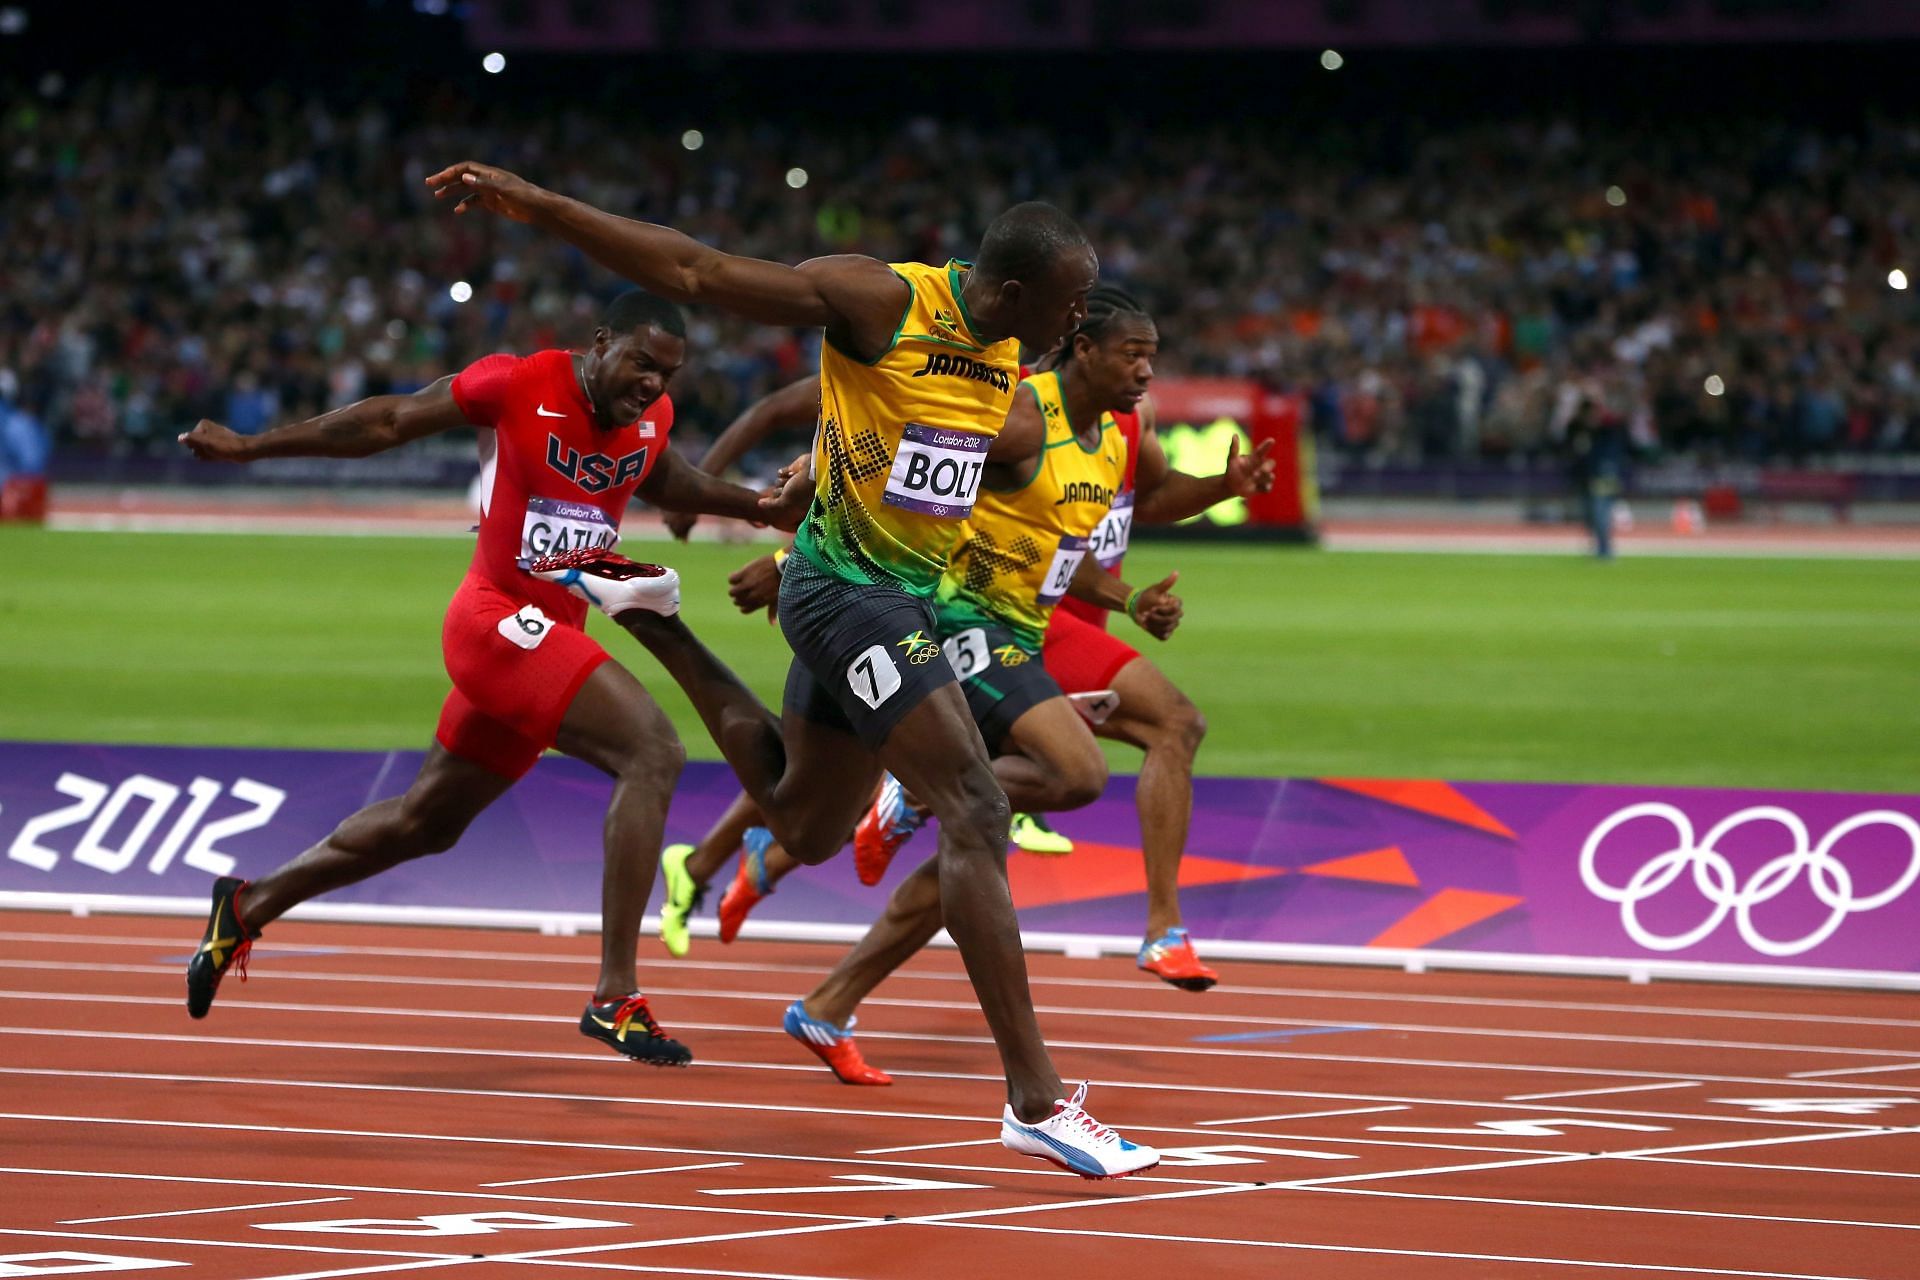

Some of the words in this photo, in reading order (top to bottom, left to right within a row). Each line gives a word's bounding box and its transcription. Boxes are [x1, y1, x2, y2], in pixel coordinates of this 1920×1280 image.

[911, 353, 1010, 396] JAMAICA
[933, 432, 963, 447] London
[964, 437, 981, 448] 2012
[546, 432, 648, 495] USA
[903, 451, 982, 498] BOLT
[1055, 482, 1116, 510] JAMAIC
[556, 505, 590, 519] London
[590, 509, 604, 521] 20
[515, 613, 545, 636] 6
[955, 635, 976, 674] 5
[854, 655, 881, 702] 7
[8, 772, 287, 876] 2012
[695, 1174, 995, 1195] 7
[249, 1211, 634, 1236] 8
